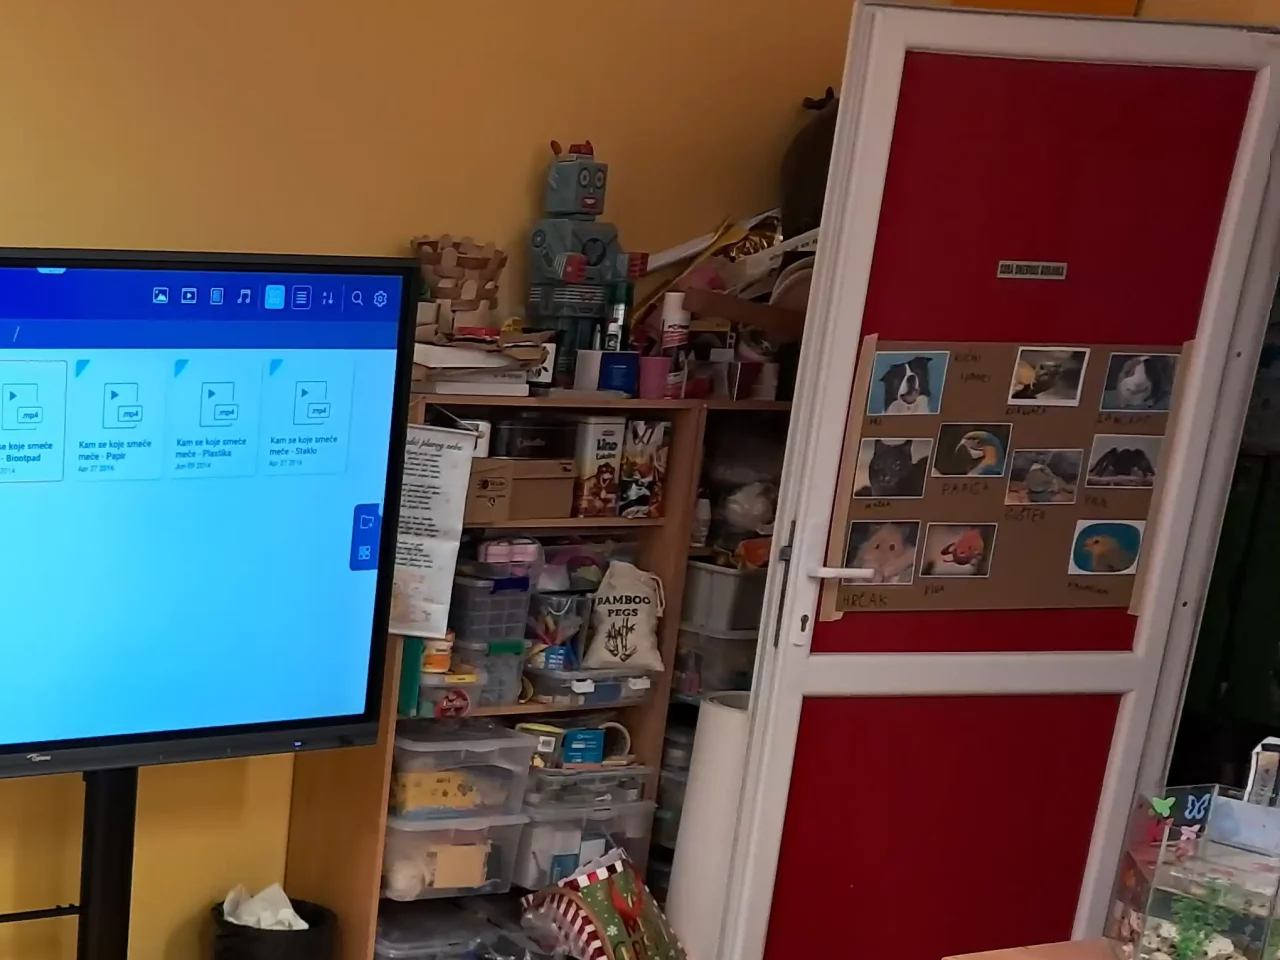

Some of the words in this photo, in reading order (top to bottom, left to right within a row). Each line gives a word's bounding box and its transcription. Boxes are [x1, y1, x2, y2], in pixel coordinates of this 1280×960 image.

[22, 411, 39, 420] .mp4
[78, 441, 96, 449] Kam
[109, 440, 124, 450] koje
[176, 438, 193, 446] Kam
[205, 437, 220, 447] koje
[270, 436, 286, 444] Kam
[298, 435, 313, 445] koje
[597, 438, 618, 451] Lino
[8, 442, 25, 452] koje
[295, 447, 317, 455] Staklo
[106, 452, 126, 461] Papir
[597, 594, 651, 606] BAMBOO
[607, 608, 639, 617] PEGS
